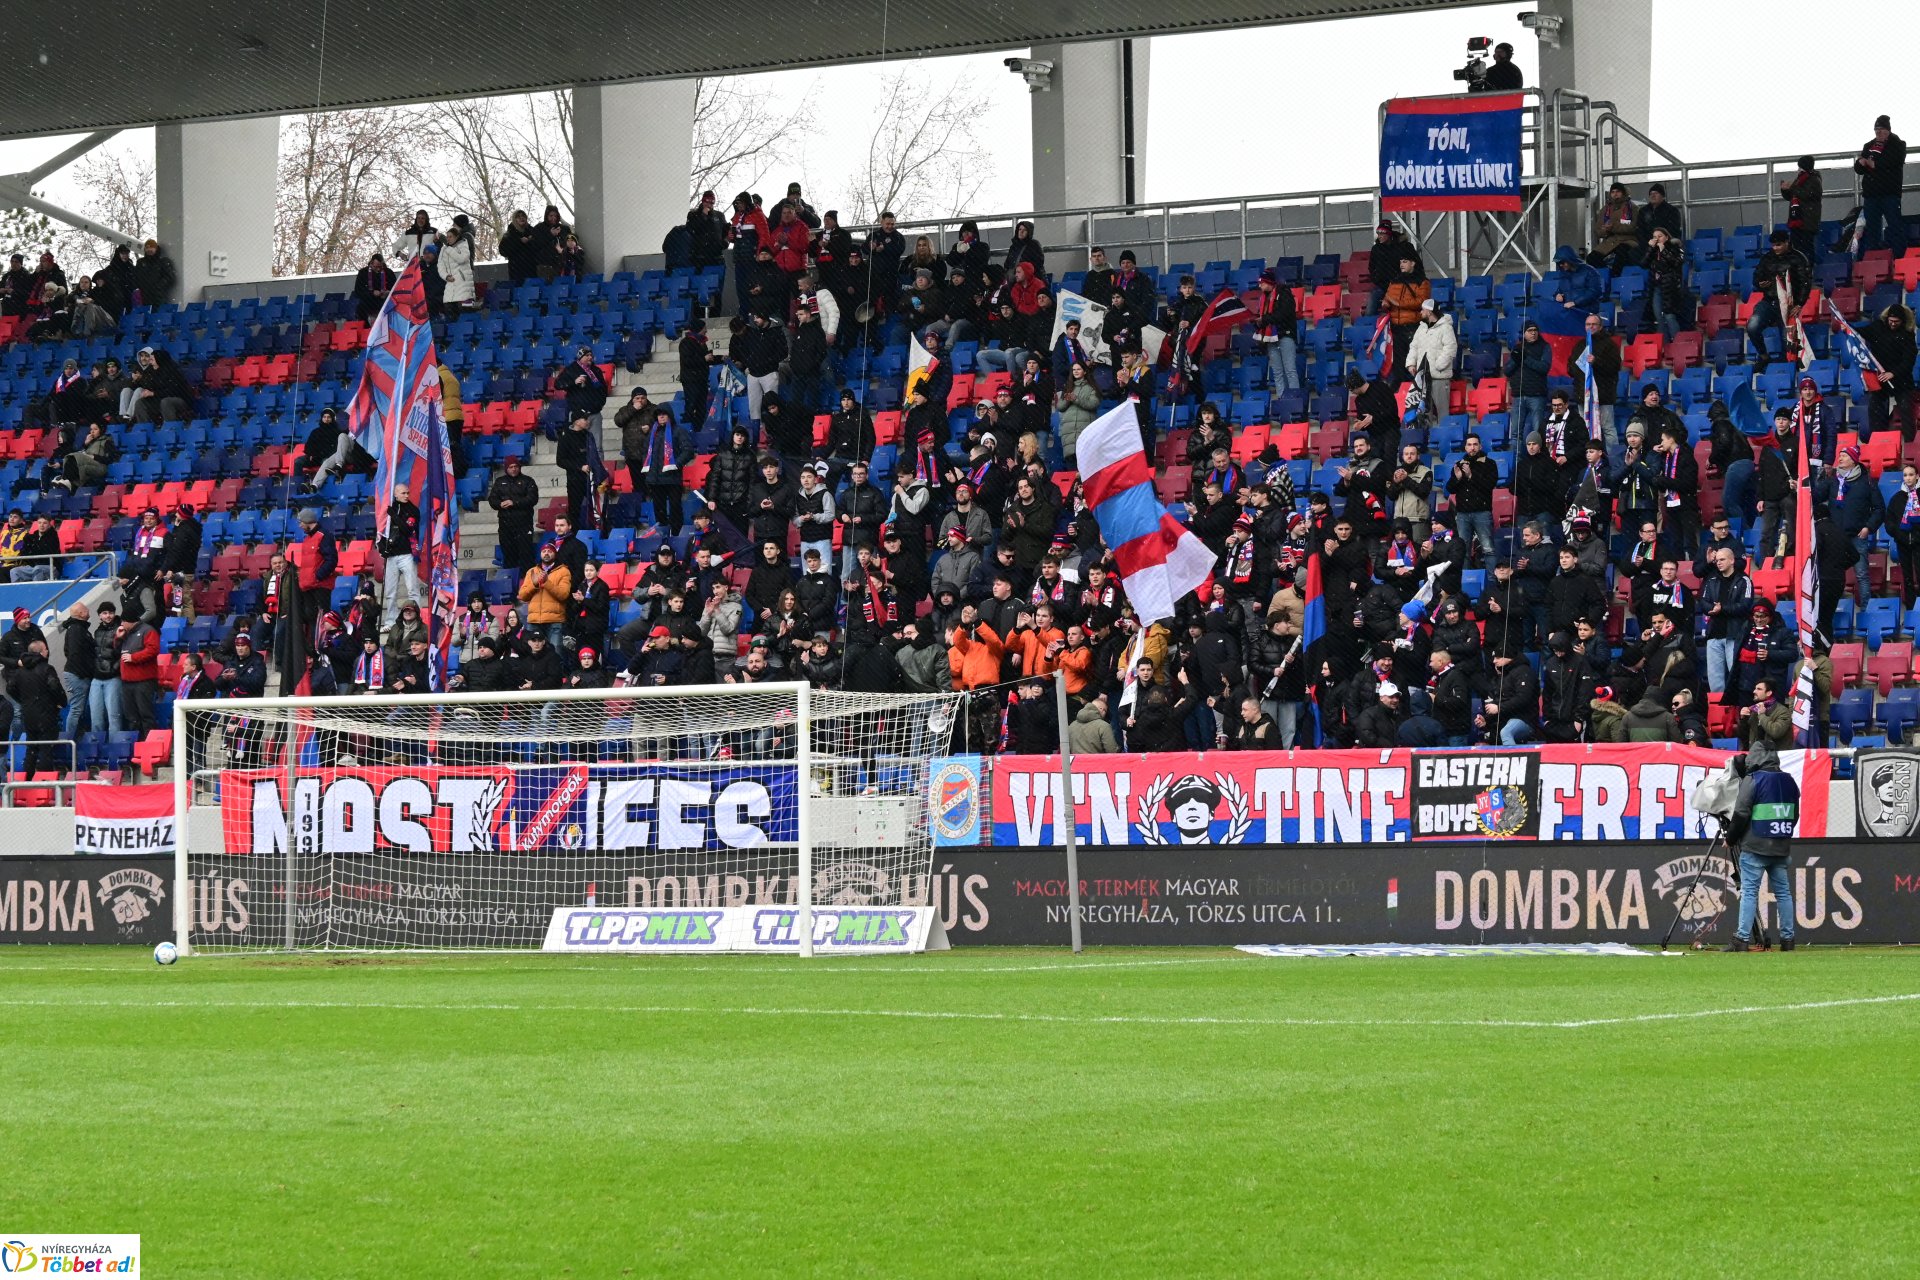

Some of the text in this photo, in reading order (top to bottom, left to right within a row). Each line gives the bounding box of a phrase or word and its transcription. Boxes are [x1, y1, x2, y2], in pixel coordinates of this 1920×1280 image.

[1428, 122, 1471, 153] TÓNI,
[1447, 158, 1514, 189] VELÜNK!
[711, 340, 720, 349] 15
[550, 477, 559, 487] 11
[463, 549, 474, 558] 09
[1419, 756, 1528, 788] EASTERN
[1254, 749, 1407, 844] TINÉ
[1895, 761, 1912, 825] NYSFC
[1419, 803, 1478, 833] BOYS
[1772, 804, 1791, 818] TV
[1769, 821, 1793, 835] 365
[1669, 858, 1730, 878] DOMBKA
[108, 870, 153, 888] DOMBKA
[1165, 878, 1240, 896] MAGYAR
[1436, 869, 1650, 930] DOMBKA
[1187, 901, 1246, 923] TÖRZS
[1253, 904, 1307, 923] UTCA
[1314, 904, 1342, 923] 11.
